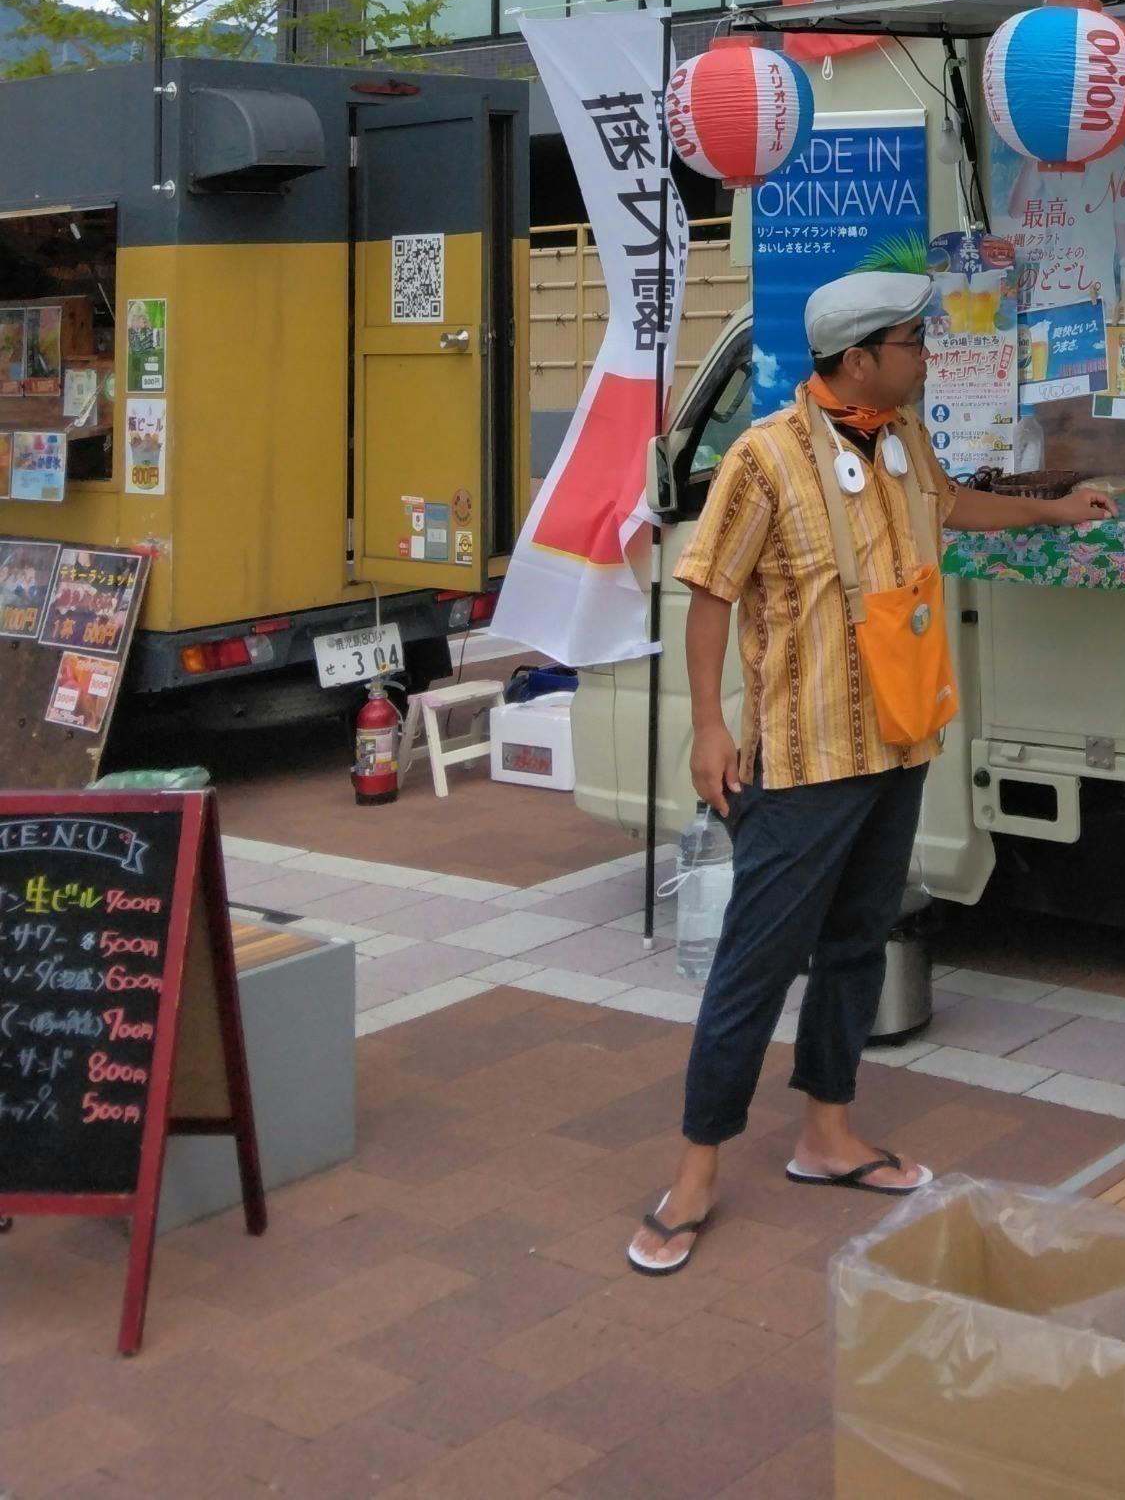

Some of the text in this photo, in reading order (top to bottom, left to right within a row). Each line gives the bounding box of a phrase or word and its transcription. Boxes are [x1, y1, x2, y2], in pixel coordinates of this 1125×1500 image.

[768, 63, 787, 152] オリオンビール
[780, 136, 900, 175] ADE IN
[757, 180, 921, 217] OKINAWA
[1022, 198, 1075, 229] 最高。
[757, 226, 868, 238] リゾートアイランド沖縄の
[1018, 262, 1102, 292] のどごし。
[128, 416, 163, 432] 瓶ビール
[325, 663, 336, 676] せ
